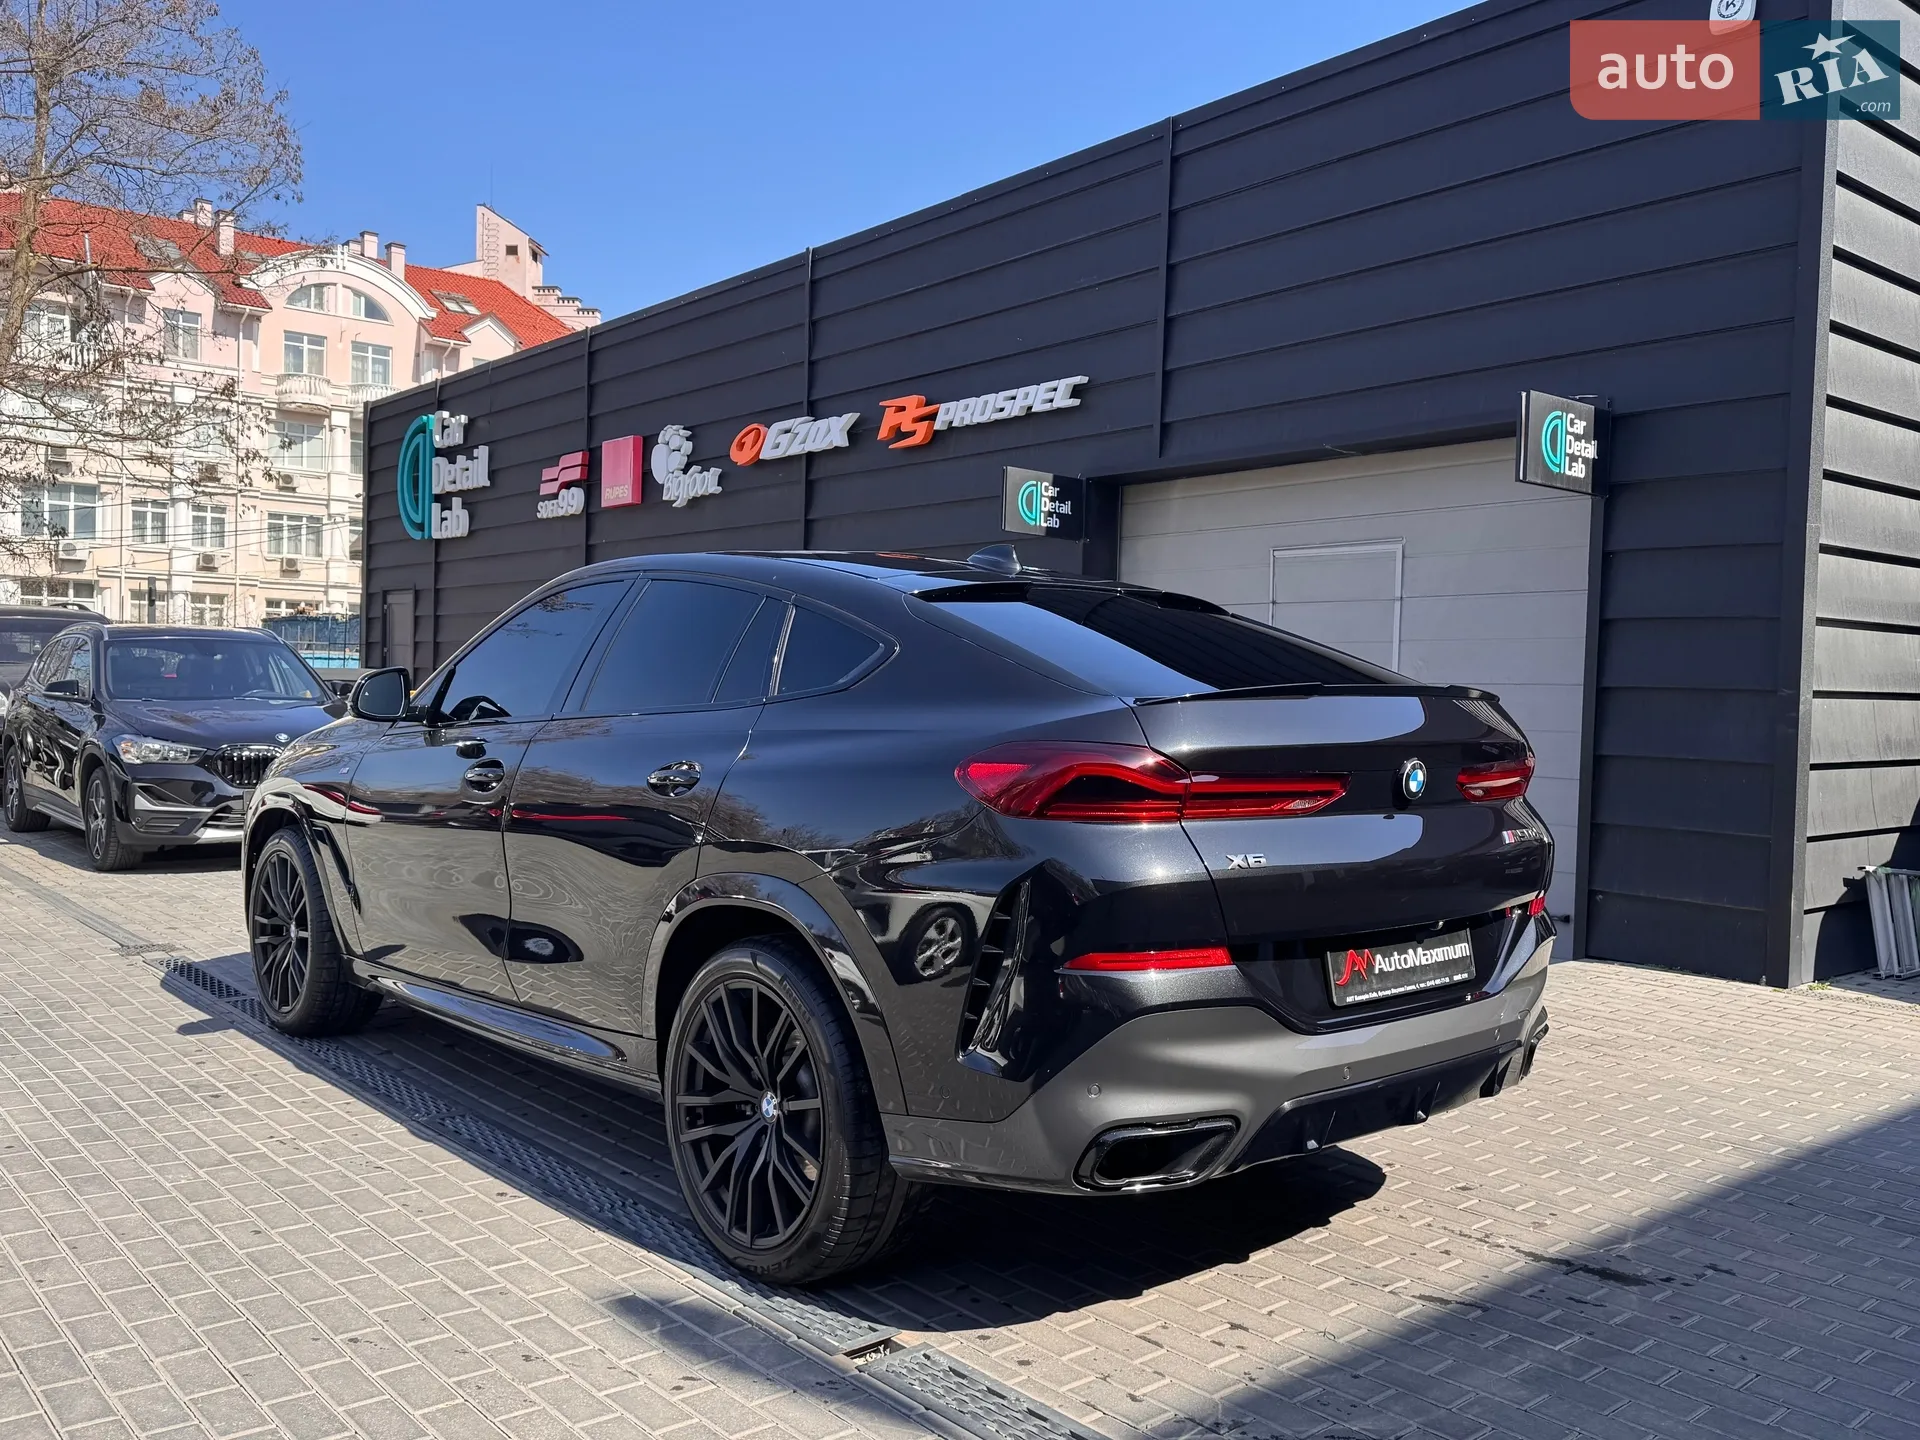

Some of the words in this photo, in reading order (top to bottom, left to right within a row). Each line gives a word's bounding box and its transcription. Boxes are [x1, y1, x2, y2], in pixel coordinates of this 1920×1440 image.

[933, 375, 1090, 431] PROSPEC
[431, 410, 469, 449] Car
[1566, 412, 1587, 436] Car
[1565, 434, 1598, 460] Detail
[431, 445, 491, 495] Detail
[1565, 455, 1586, 479] Lab
[604, 484, 629, 501] RUPES
[1041, 481, 1060, 497] Car
[1041, 496, 1072, 515] Detail
[430, 496, 470, 540] Lab
[1040, 512, 1060, 528] Lab
[1225, 853, 1267, 870] X6
